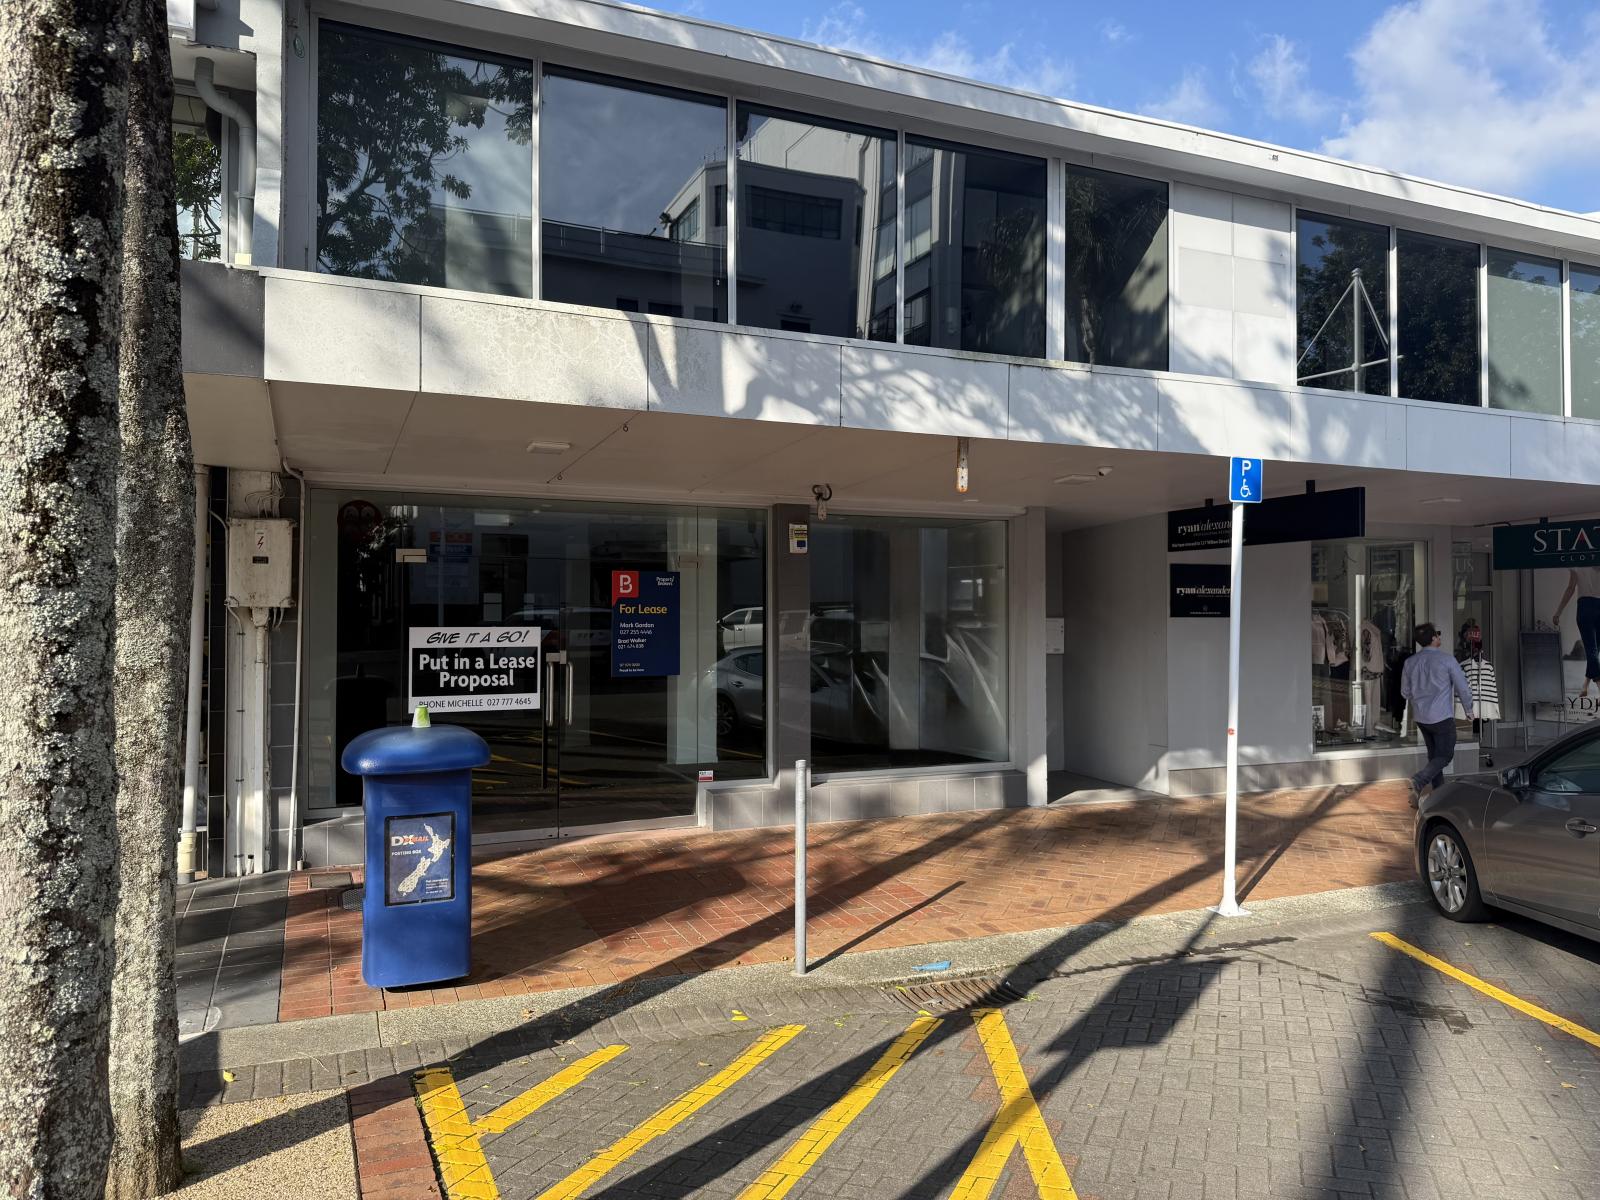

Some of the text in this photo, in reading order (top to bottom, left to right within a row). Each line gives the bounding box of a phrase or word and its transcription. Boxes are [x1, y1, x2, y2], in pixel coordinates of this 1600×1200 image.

[1242, 460, 1252, 476] P
[620, 574, 633, 593] B
[620, 604, 668, 614] For Lease
[427, 630, 530, 644] GIVE IT A GO!
[419, 653, 536, 671] Put in a Lease
[440, 668, 514, 692] Proposal
[418, 699, 484, 709] PHONE MICHELLE
[486, 697, 532, 706] 027 777 4645
